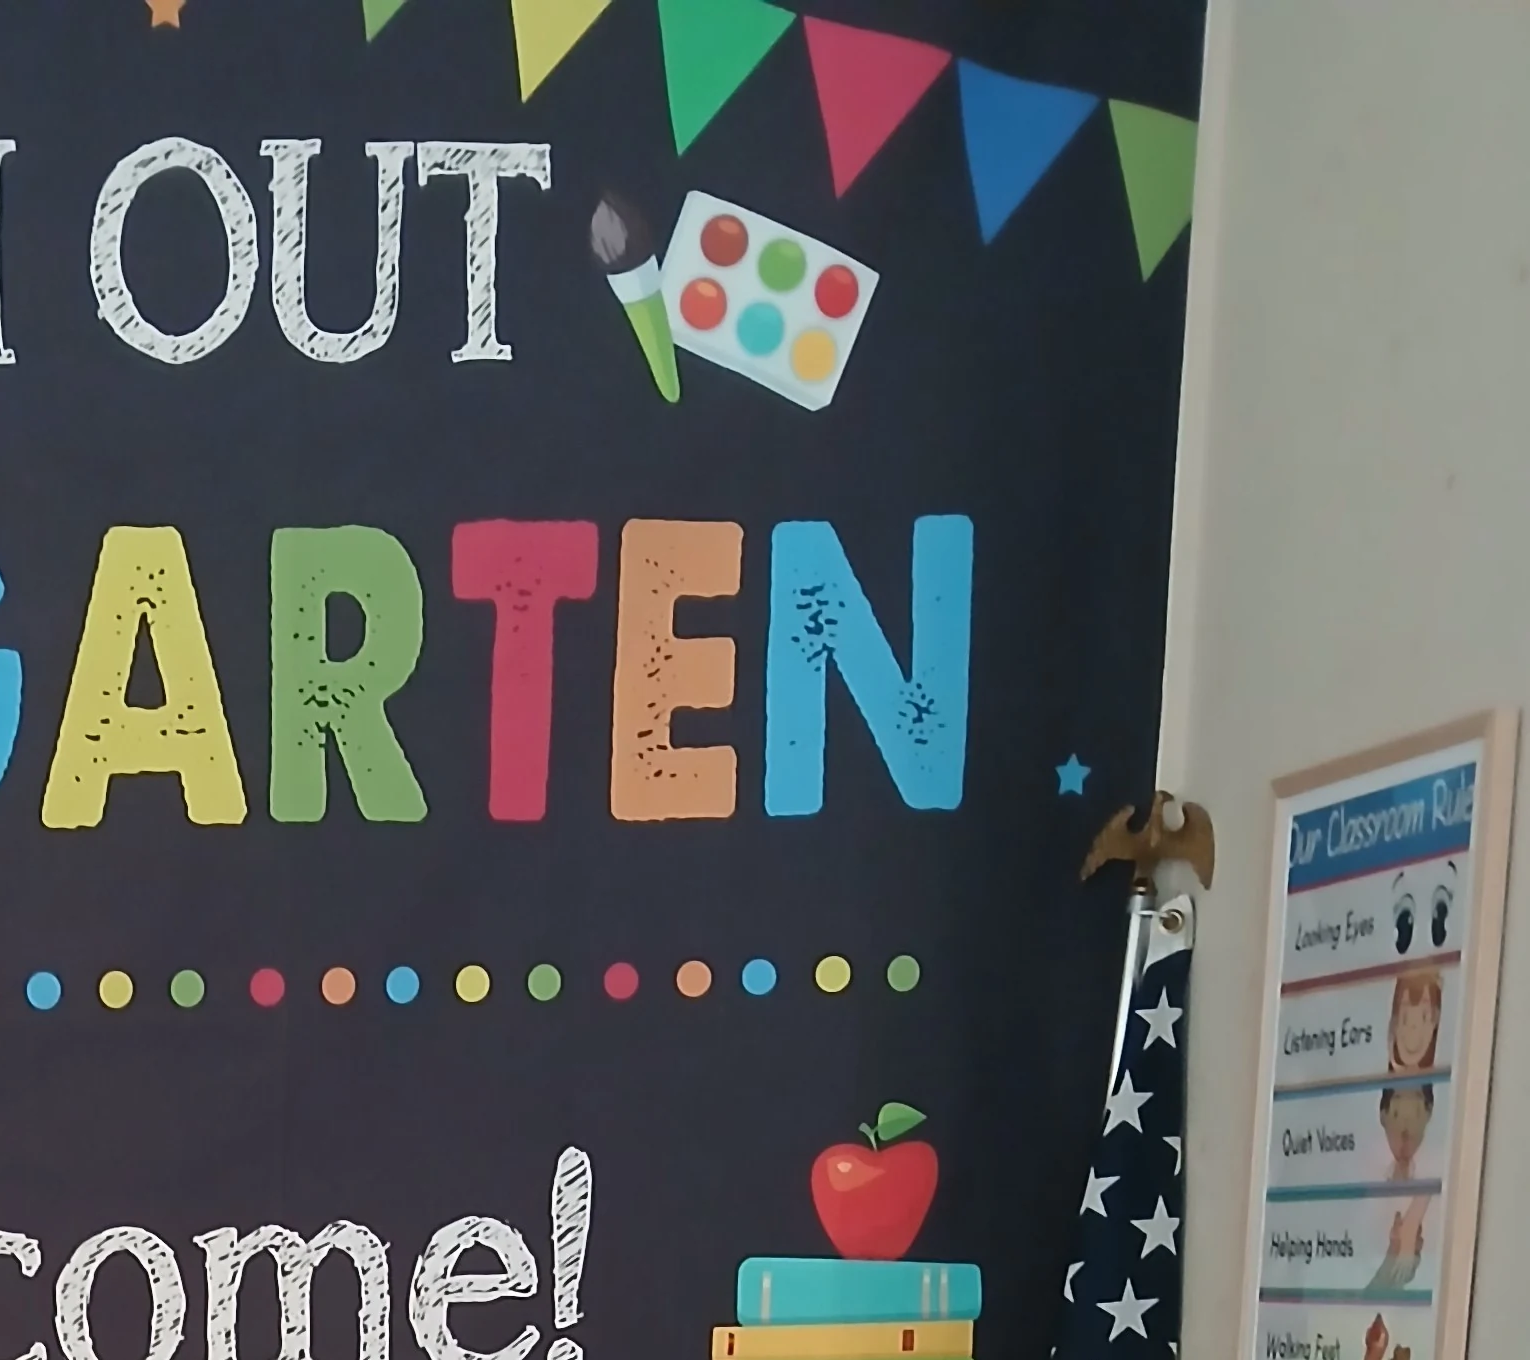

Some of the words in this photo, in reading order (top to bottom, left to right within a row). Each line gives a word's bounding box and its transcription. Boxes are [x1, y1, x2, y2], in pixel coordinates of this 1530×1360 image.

[88, 135, 553, 366] OUT
[1327, 798, 1425, 858] Classroom
[1295, 921, 1341, 951] Looking
[1345, 909, 1375, 944] Eyes
[1283, 1026, 1336, 1056] Listening
[1341, 1017, 1372, 1048] Ears
[1282, 1128, 1313, 1157] Quiet
[1316, 1125, 1355, 1152] Voices
[1270, 1230, 1313, 1265] Helping
[1316, 1229, 1354, 1259] Hands
